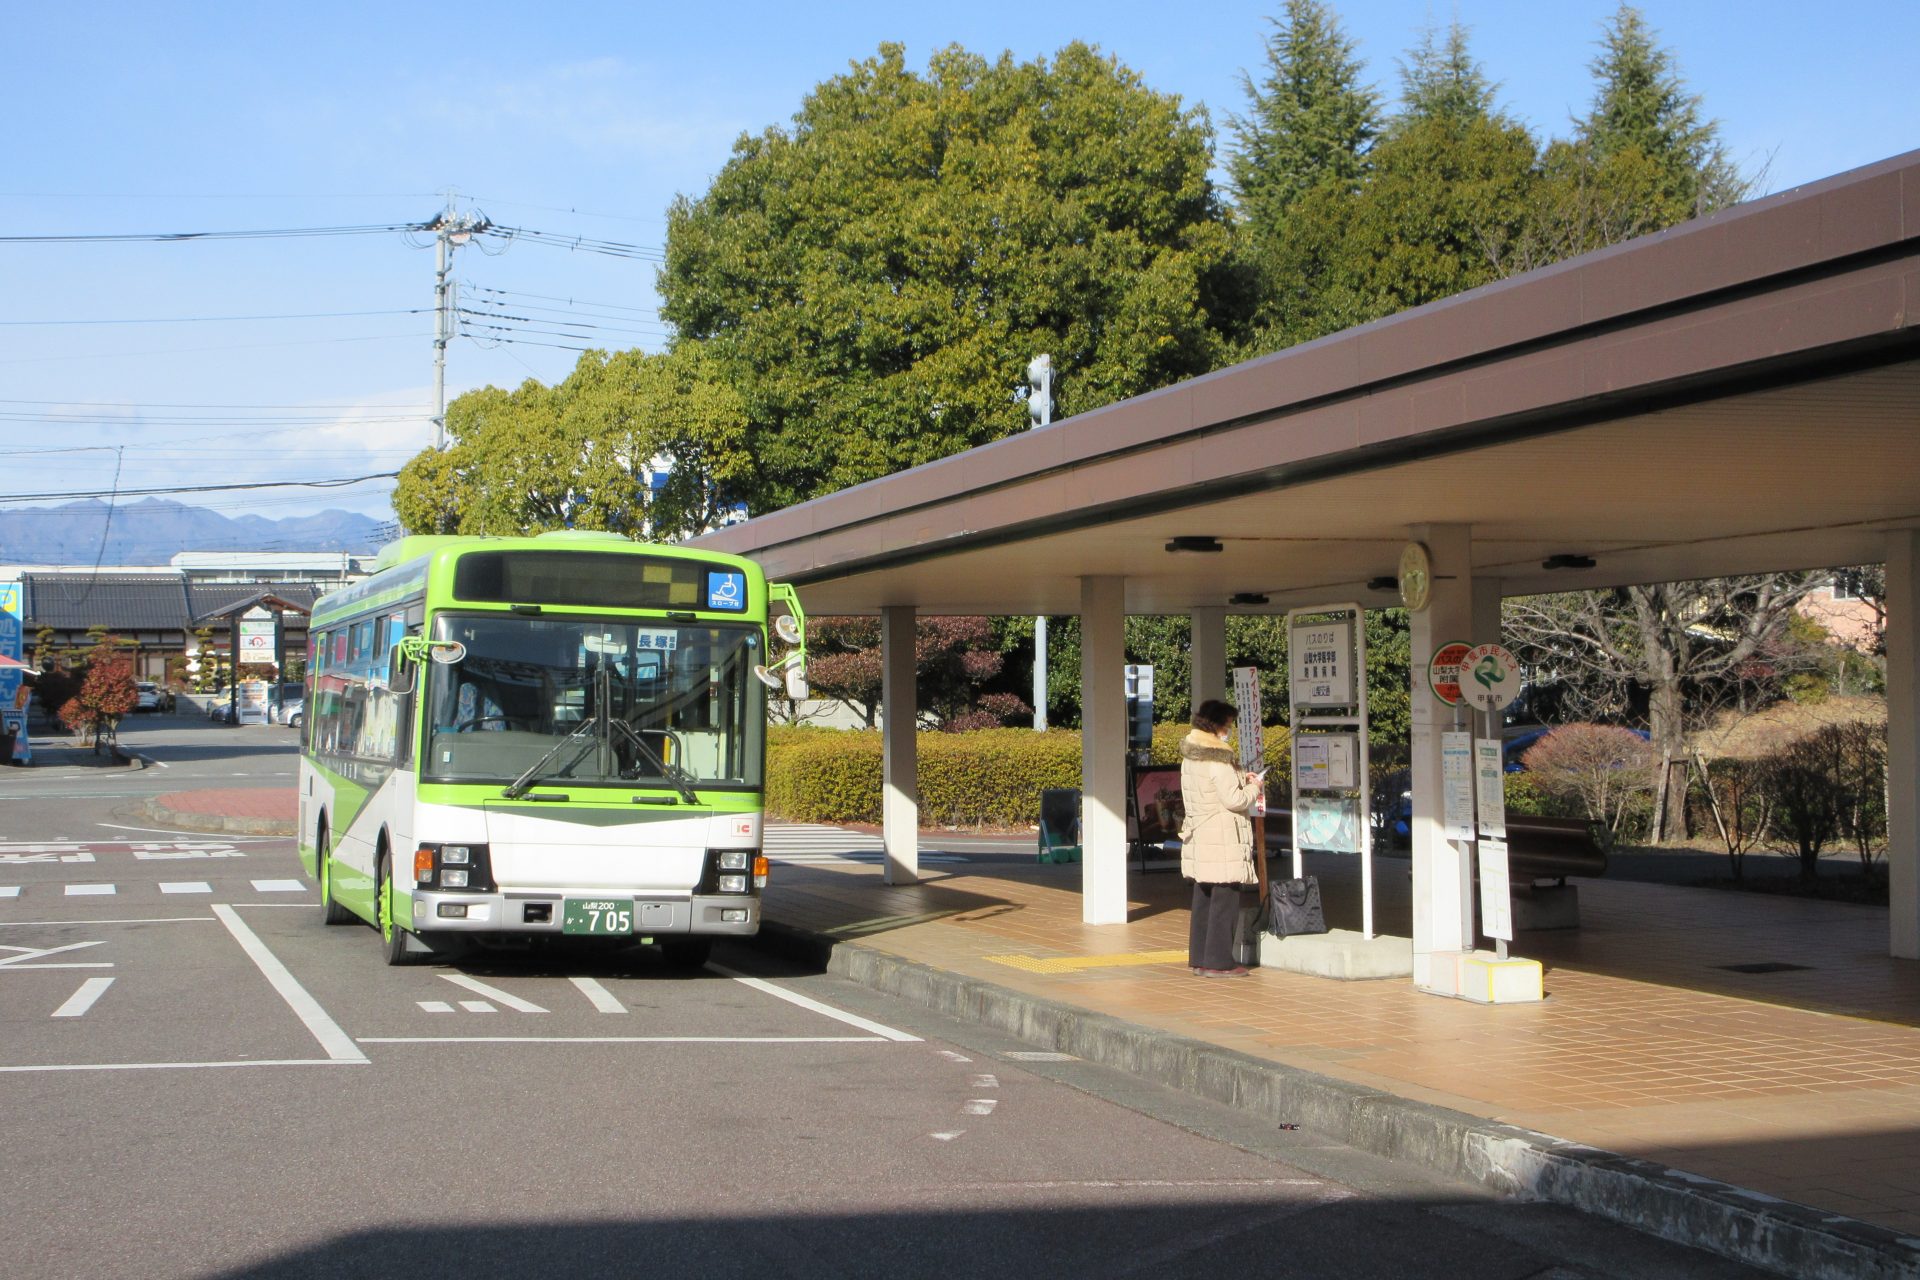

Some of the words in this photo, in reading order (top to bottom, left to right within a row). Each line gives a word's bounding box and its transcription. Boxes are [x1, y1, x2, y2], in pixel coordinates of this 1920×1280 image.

[639, 634, 668, 649] 長塚
[1461, 645, 1517, 672] 甲斐市民バス
[1477, 694, 1503, 703] 甲斐市
